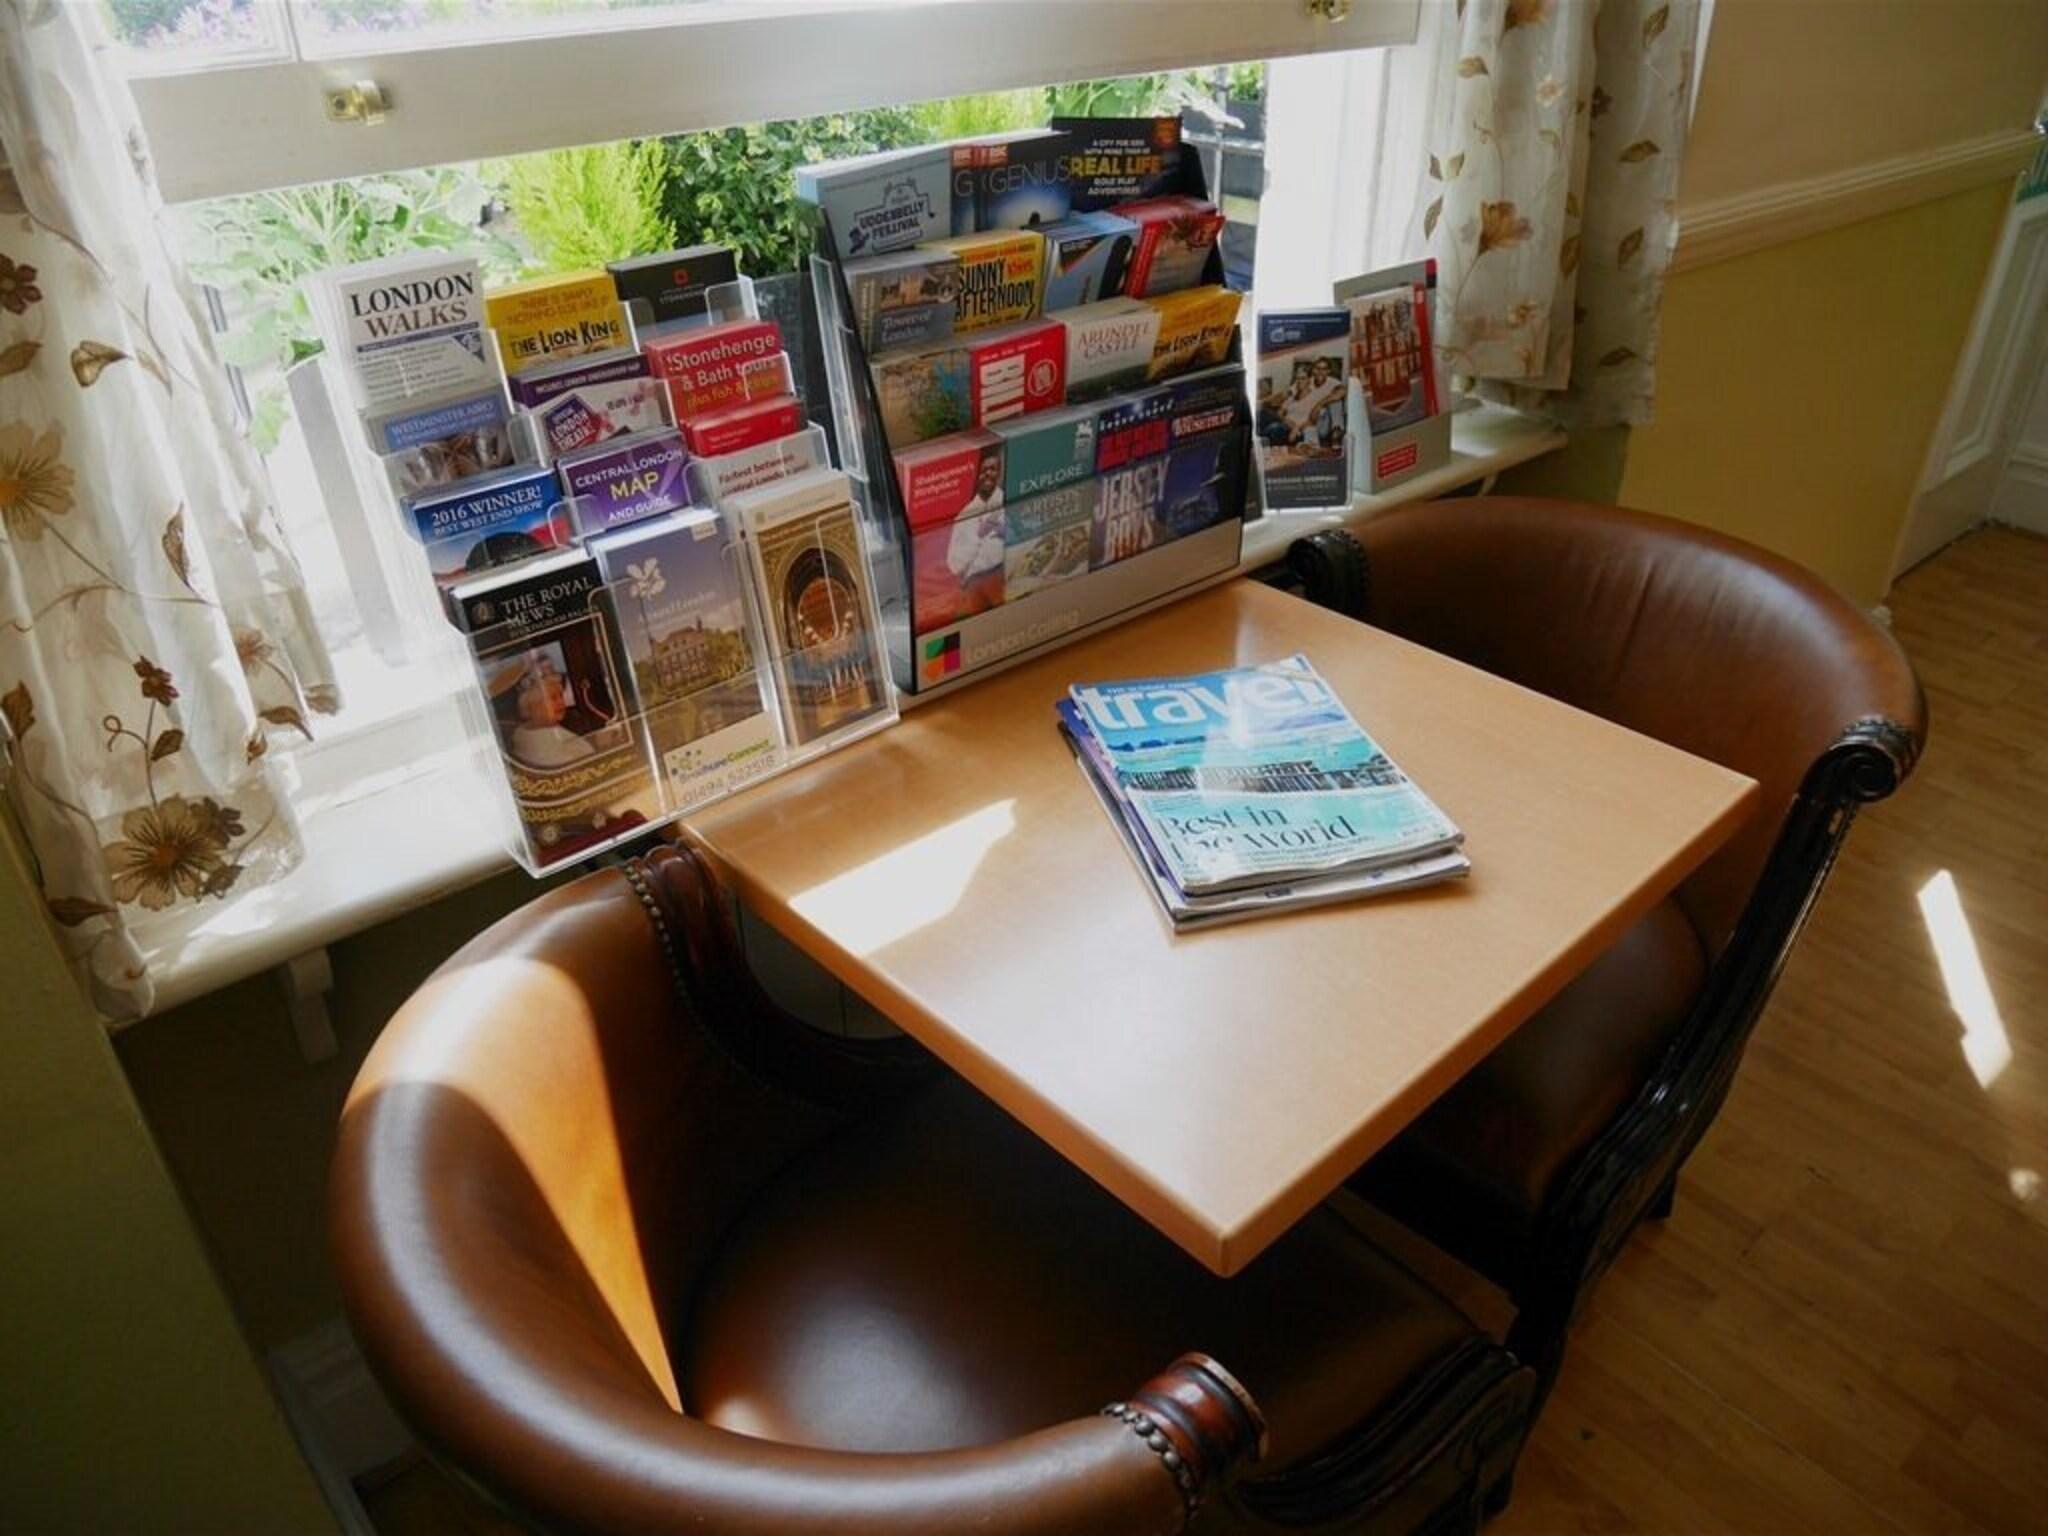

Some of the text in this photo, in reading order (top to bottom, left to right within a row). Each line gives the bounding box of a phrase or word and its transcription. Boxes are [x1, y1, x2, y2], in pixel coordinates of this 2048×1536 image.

[1071, 155, 1161, 176] REAL LIFE
[959, 259, 1006, 291] SUNNY
[351, 272, 474, 317] LONDON
[365, 301, 468, 339] WALKS
[1078, 321, 1150, 347] ARUNDEL
[511, 320, 620, 357] THE LION KING
[672, 334, 776, 370] Stonehenge
[697, 363, 733, 387] Bath
[576, 449, 682, 488] CENTRAL LONDON
[1019, 464, 1083, 496] EXPLORE
[610, 472, 659, 500] MAP
[431, 485, 542, 526] 2016 WINNER!
[608, 507, 634, 522] AND
[462, 516, 488, 530] WEST
[501, 577, 594, 615] THE ROYAL
[504, 602, 555, 627] MEWS
[1079, 668, 1330, 731] travel
[1158, 806, 1290, 838] Best in
[1243, 815, 1358, 849] World
